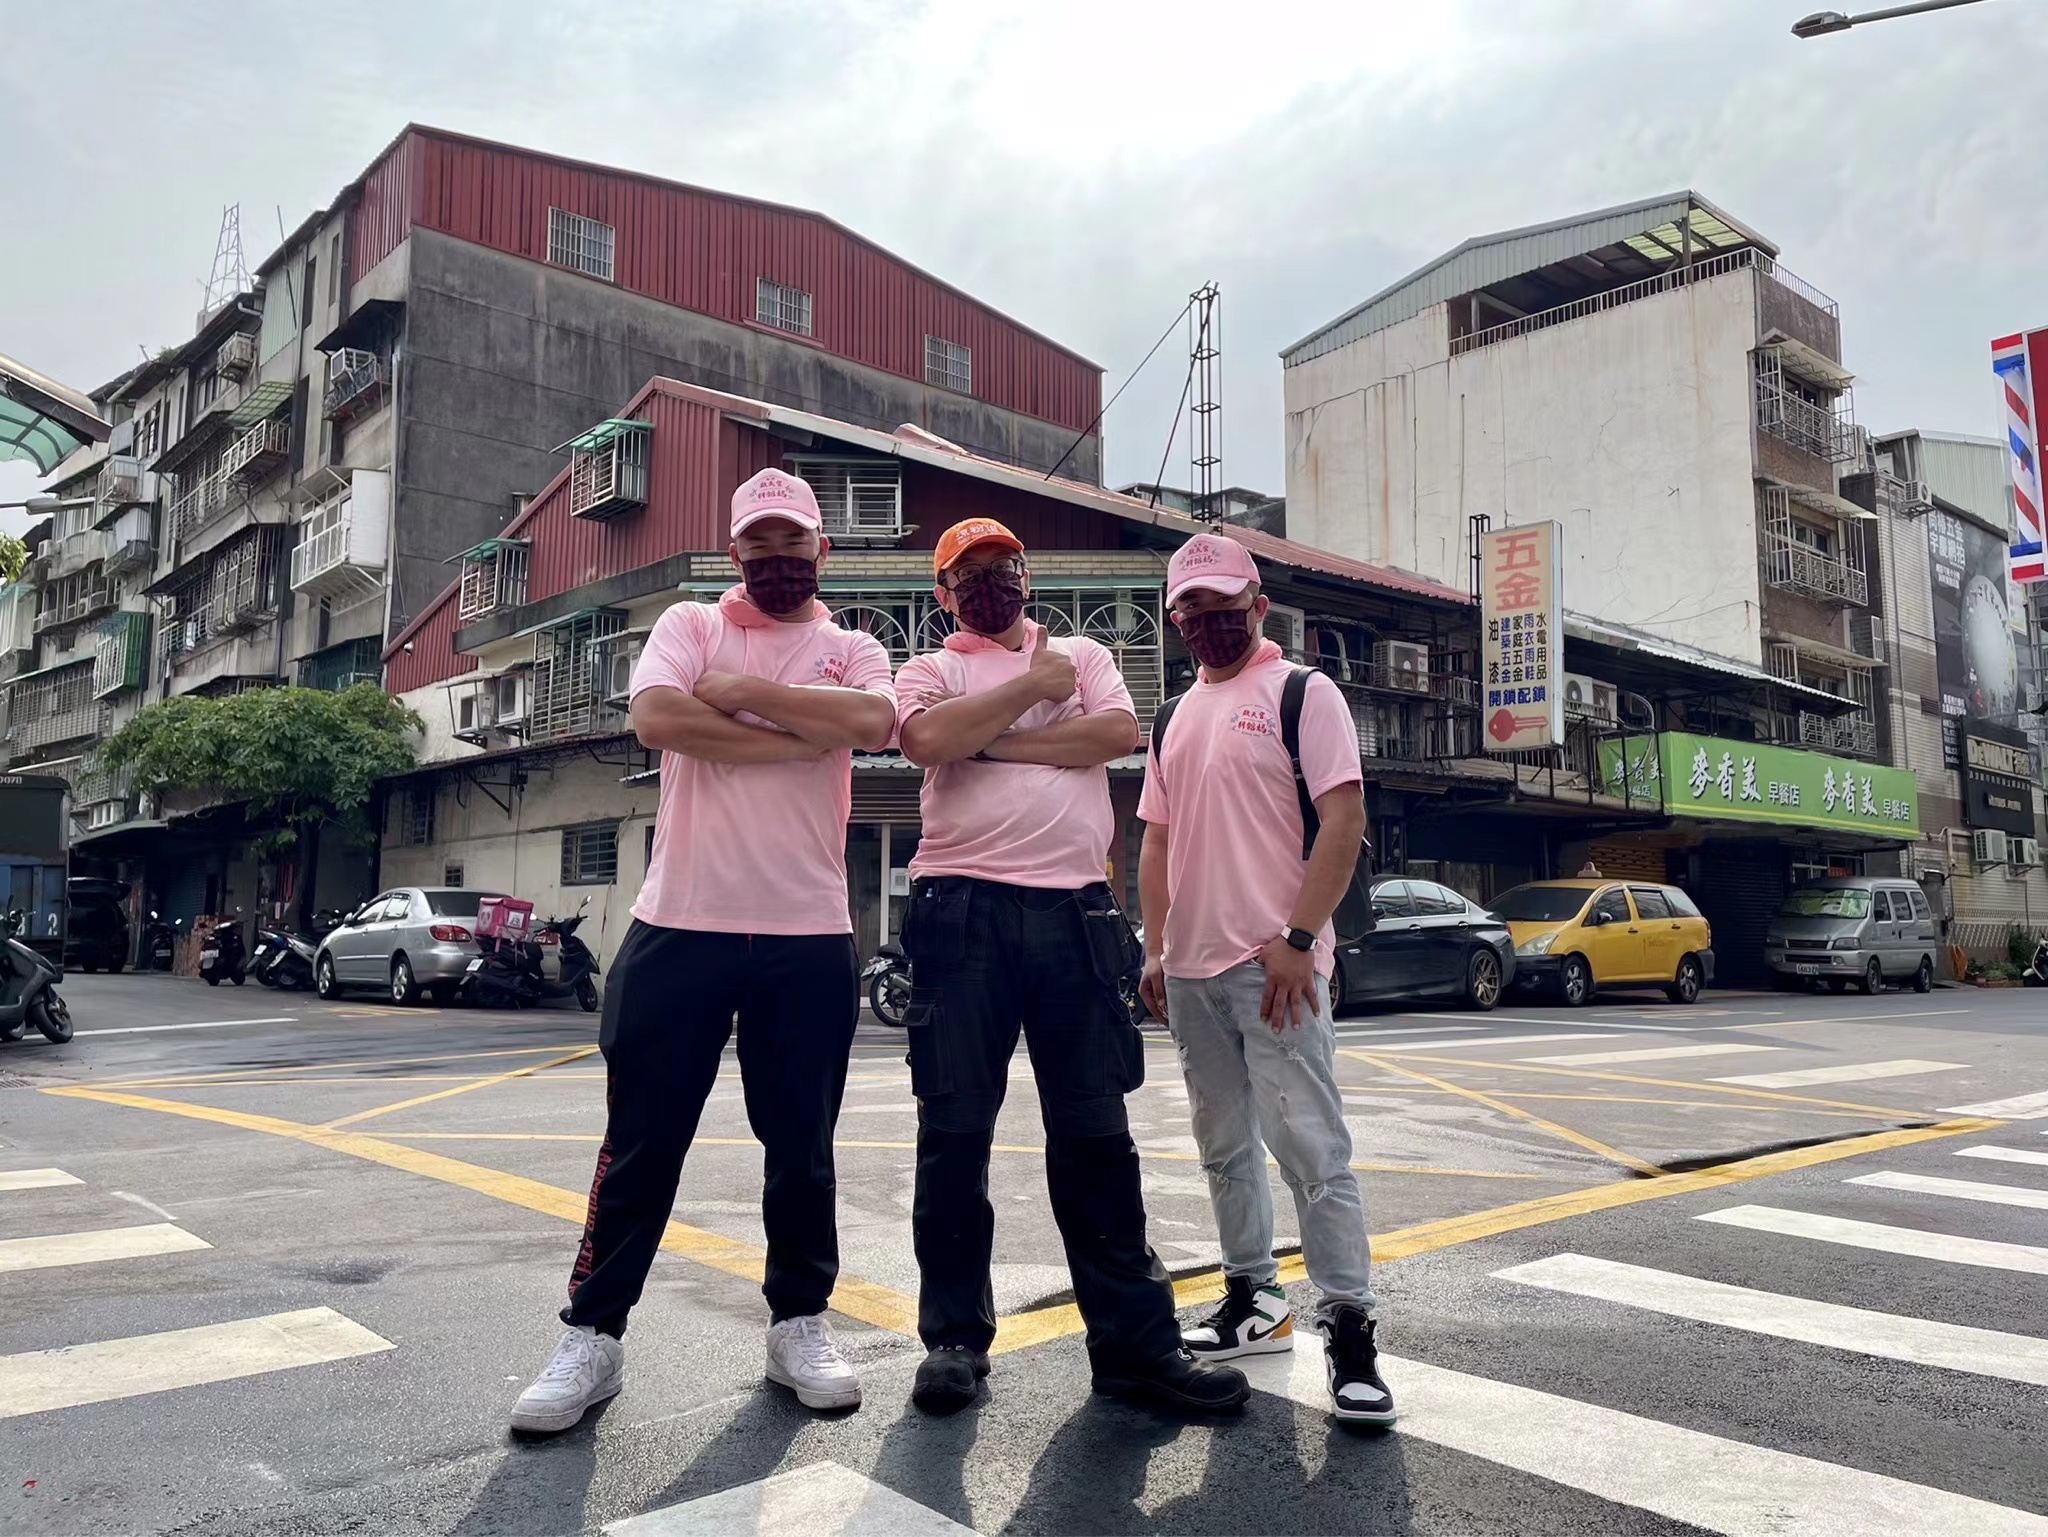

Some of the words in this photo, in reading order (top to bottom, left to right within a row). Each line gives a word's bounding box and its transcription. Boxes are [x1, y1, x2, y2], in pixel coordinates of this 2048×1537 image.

[1495, 531, 1542, 611] 五金
[1500, 618, 1512, 683] 建築五金
[1512, 615, 1523, 682] 家庭五金
[1524, 613, 1535, 681] 雨衣雨鞋
[1536, 612, 1547, 680] 水電用品
[1489, 686, 1546, 707] 開鎖配鎖
[1768, 781, 1801, 807] 早餐店
[1883, 798, 1911, 821] 早餐店
[586, 1149, 613, 1233] ARMOUR
